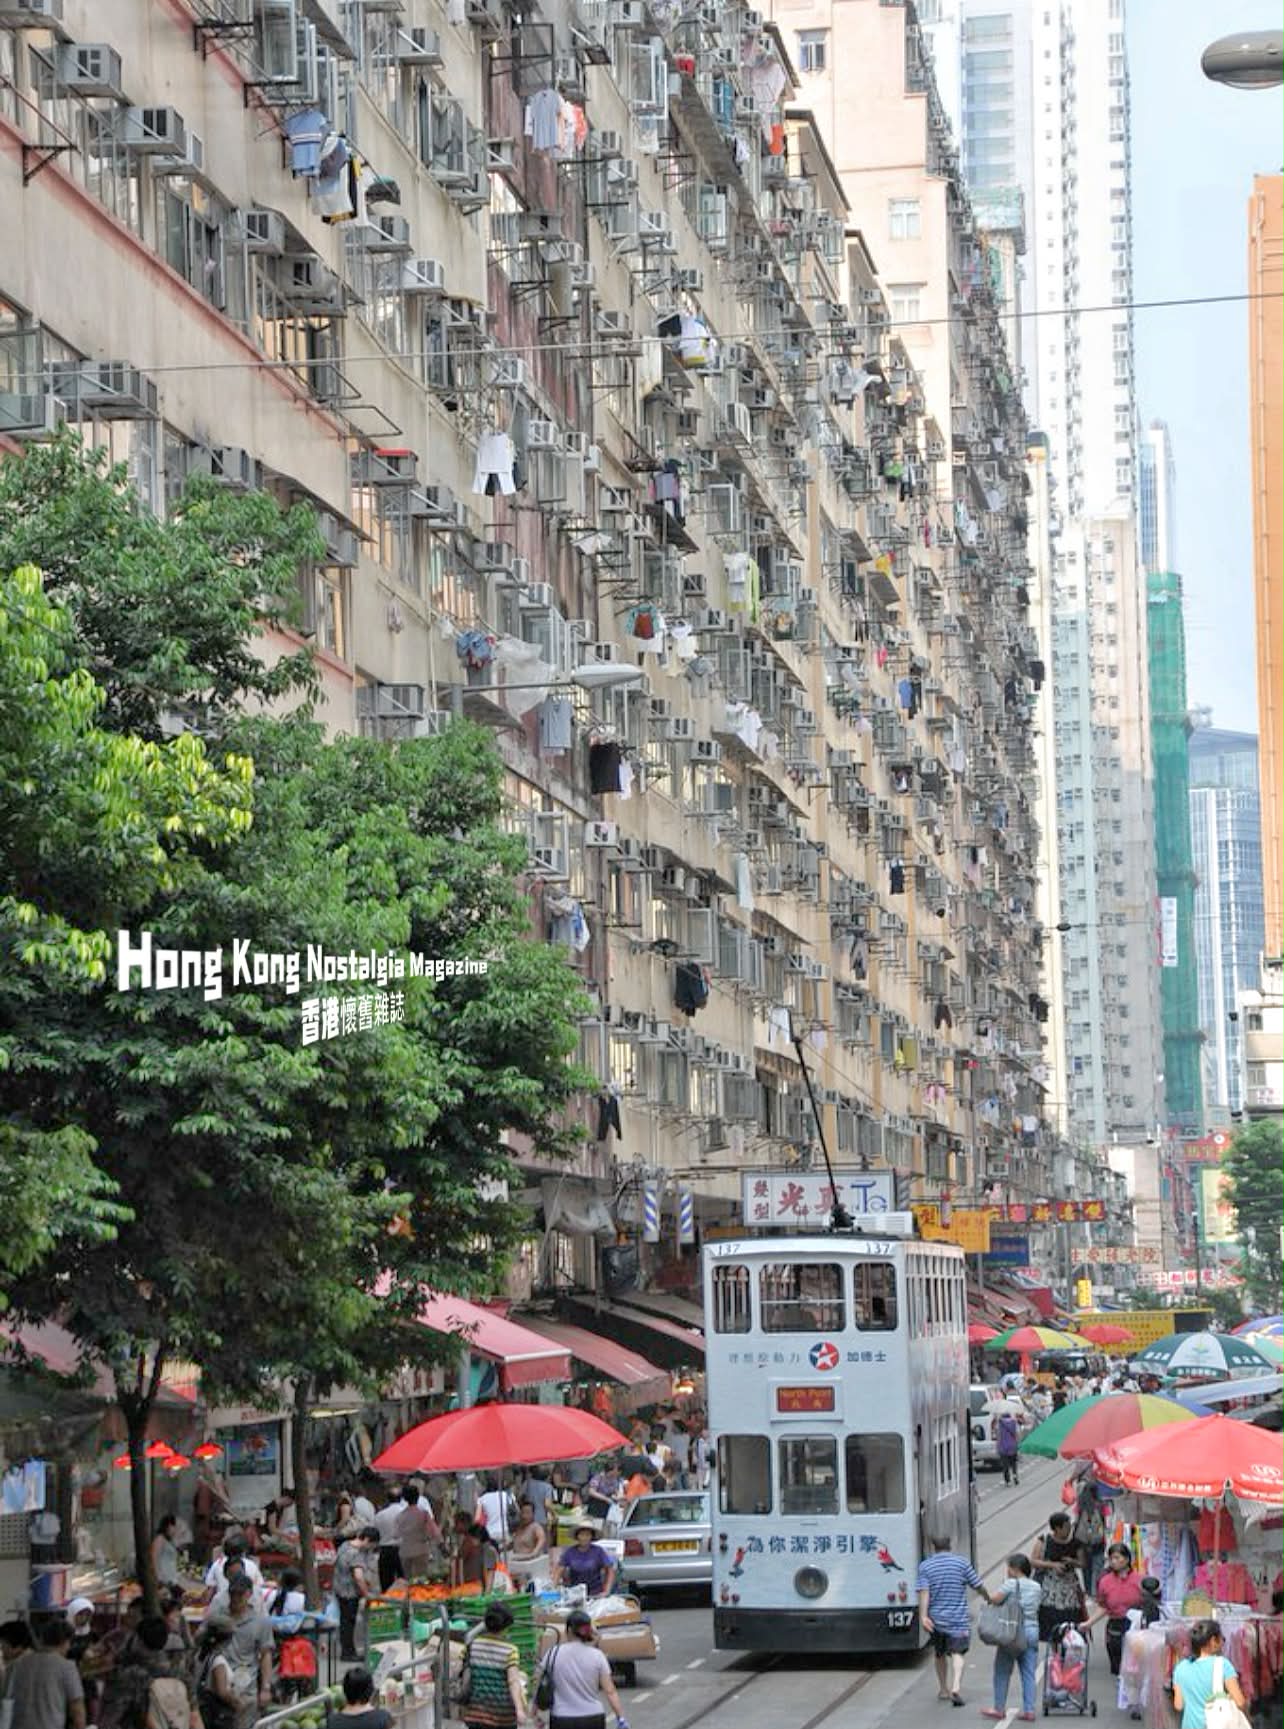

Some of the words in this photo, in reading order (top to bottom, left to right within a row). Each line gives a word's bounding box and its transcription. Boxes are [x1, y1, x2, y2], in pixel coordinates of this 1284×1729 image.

[718, 1244, 741, 1256] 137
[866, 1242, 891, 1255] 137
[847, 1351, 886, 1363] 加德士
[747, 1535, 878, 1554] 為你潔淨引擎
[887, 1611, 914, 1627] 137
